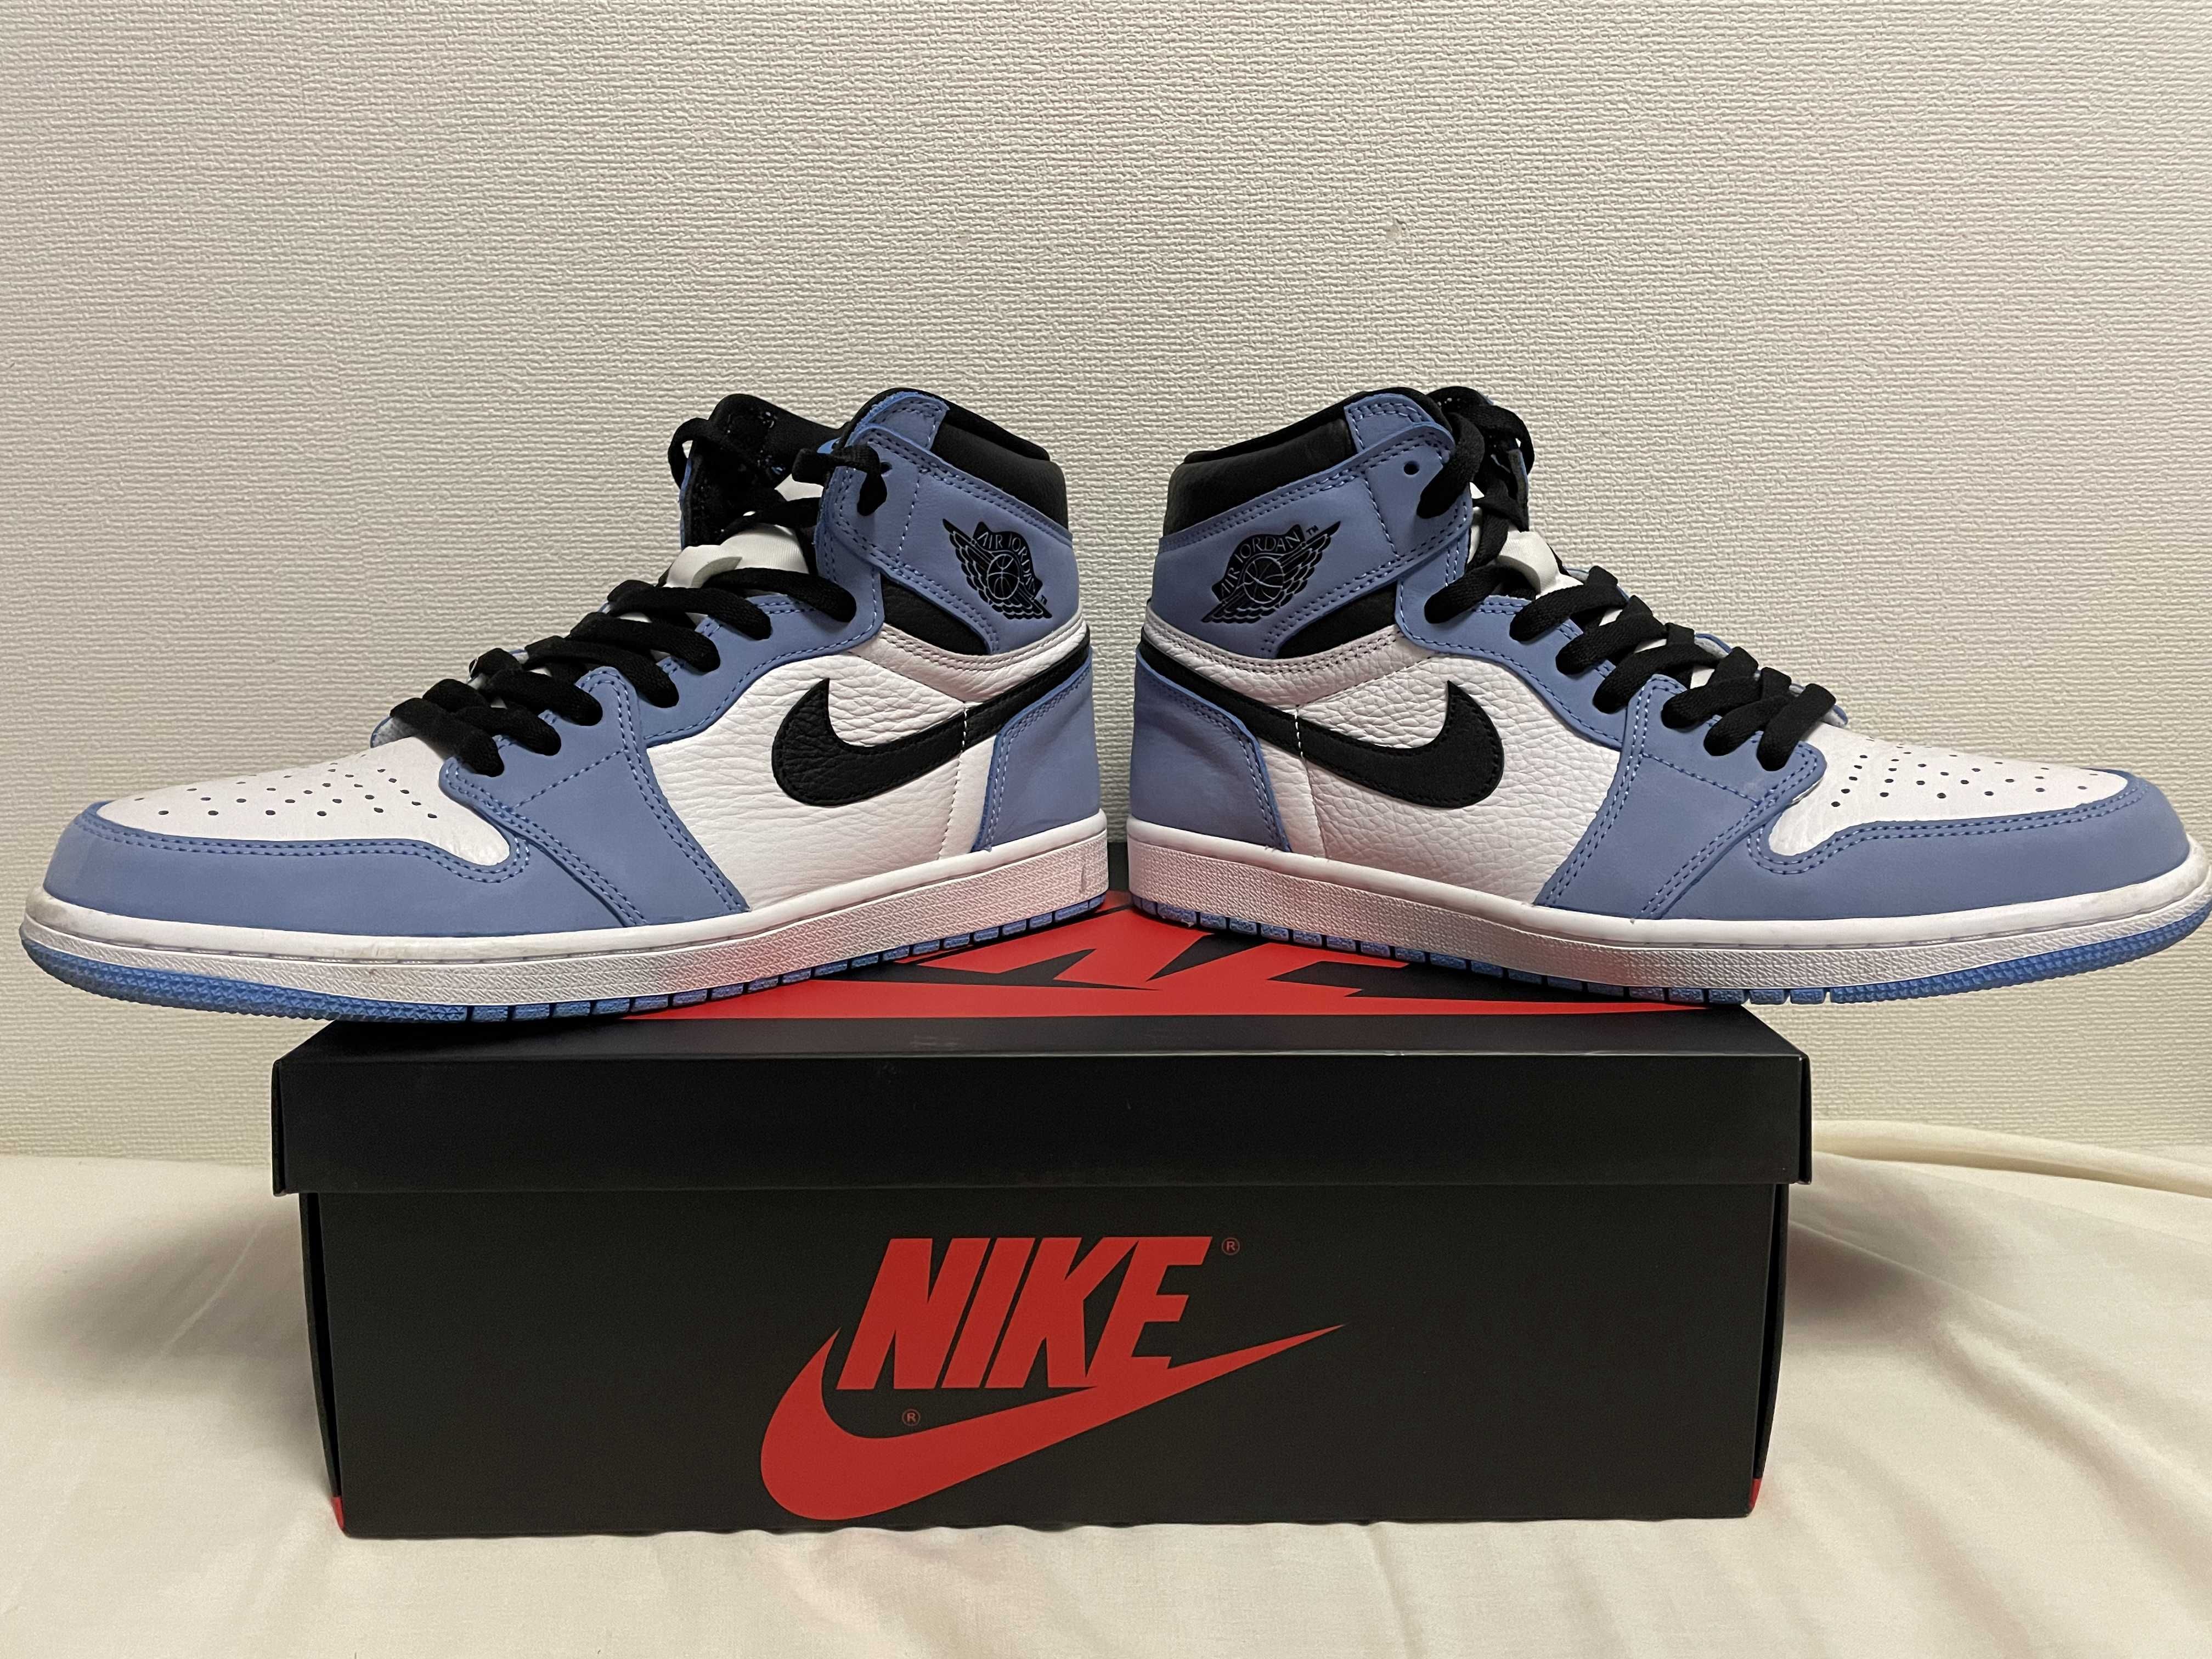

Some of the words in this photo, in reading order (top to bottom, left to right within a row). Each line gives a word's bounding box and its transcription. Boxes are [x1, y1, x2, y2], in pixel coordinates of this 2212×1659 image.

[977, 531, 1003, 549] AIR
[1221, 567, 1240, 598] AIR
[836, 1236, 1212, 1390] NIKE
